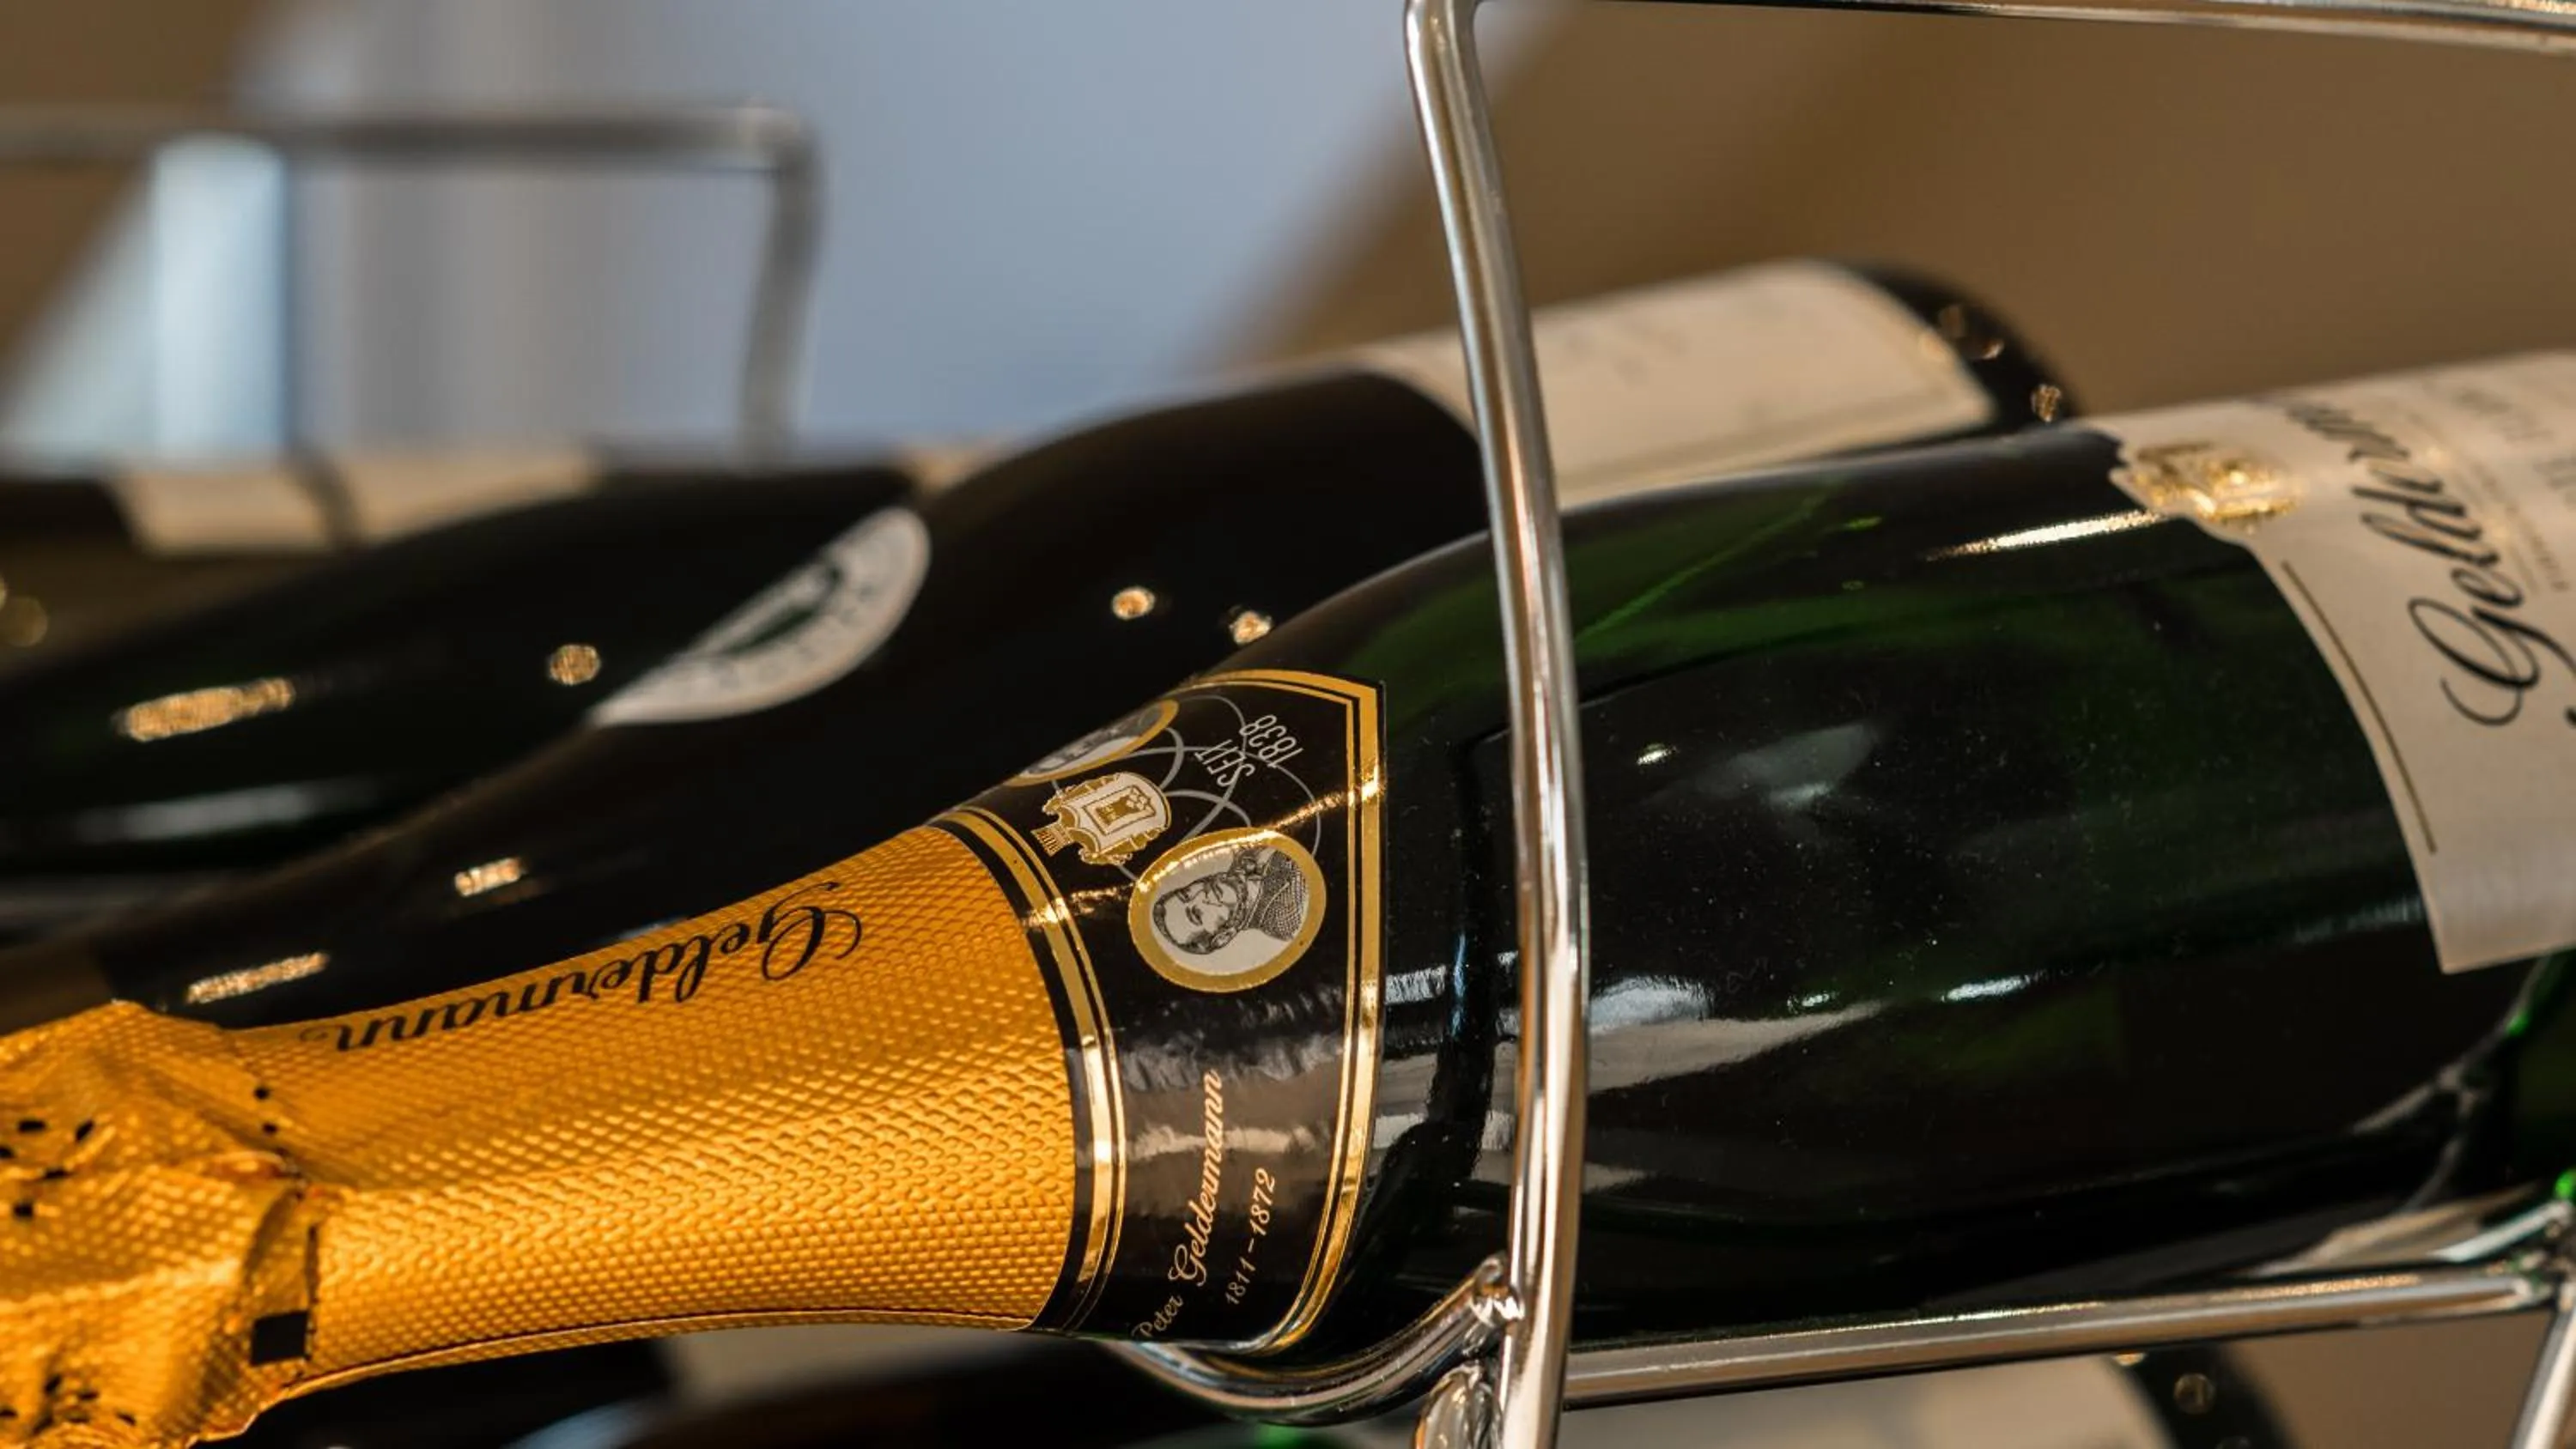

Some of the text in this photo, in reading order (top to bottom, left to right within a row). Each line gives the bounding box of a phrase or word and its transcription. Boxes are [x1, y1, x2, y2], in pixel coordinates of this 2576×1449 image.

[1194, 739, 1255, 787] SEIT
[1239, 714, 1303, 768] 1838
[299, 882, 862, 1052] Geldermann
[1131, 1070, 1223, 1337] Peter Geldermann
